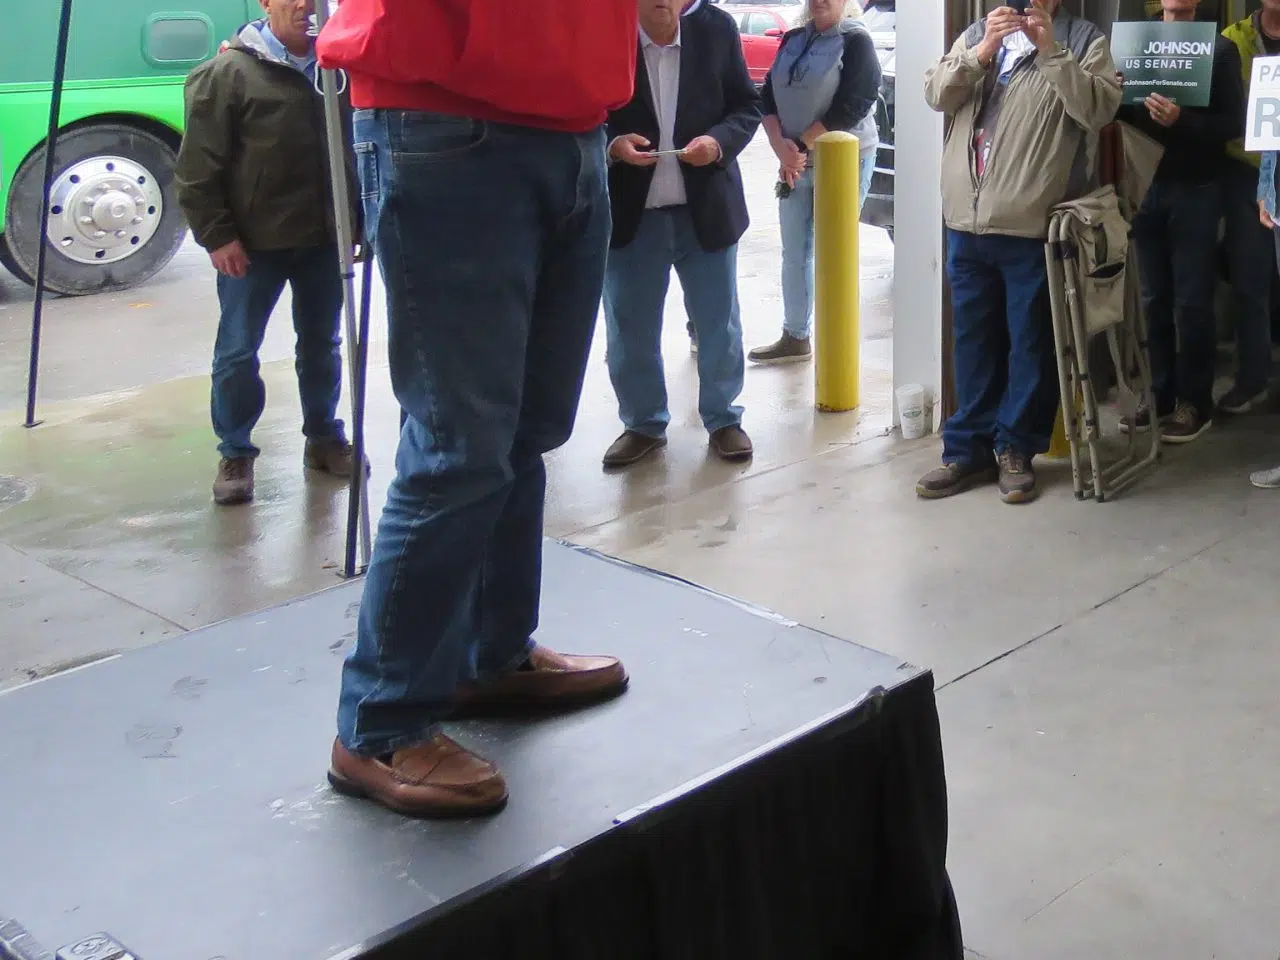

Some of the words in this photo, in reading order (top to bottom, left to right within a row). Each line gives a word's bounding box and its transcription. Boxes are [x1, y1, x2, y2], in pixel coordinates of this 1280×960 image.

[1143, 41, 1212, 55] JOHNSON
[1125, 59, 1141, 69] US
[1144, 59, 1193, 69] SENATE
